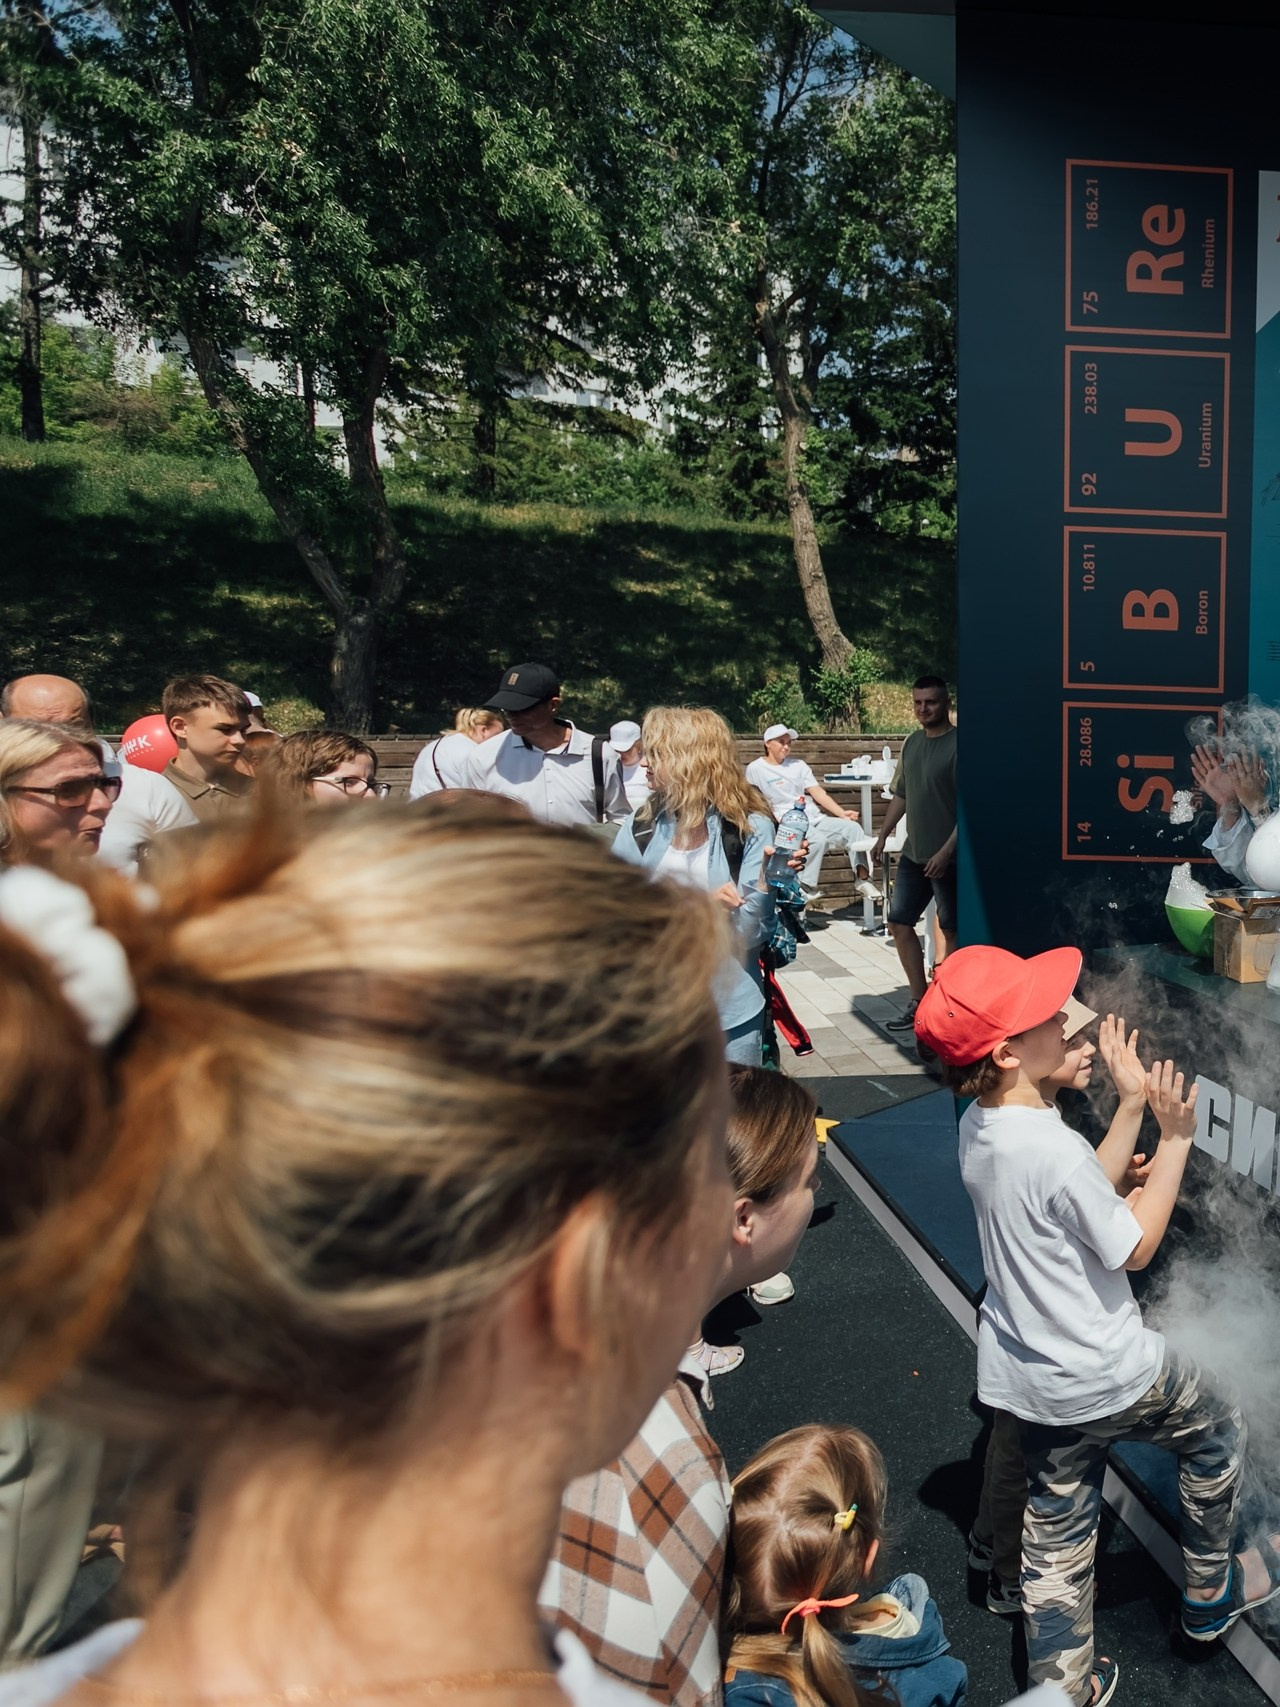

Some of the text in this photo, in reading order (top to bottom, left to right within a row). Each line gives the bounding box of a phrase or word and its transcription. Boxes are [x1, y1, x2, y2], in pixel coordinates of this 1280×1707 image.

[1086, 177, 1099, 230] 186.21
[1126, 203, 1186, 295] Re
[1202, 218, 1215, 288] Rhenium
[1082, 291, 1099, 314] 75
[1084, 362, 1098, 415] 238.03
[1124, 408, 1183, 457] U
[1198, 402, 1213, 468] Uranium
[1081, 472, 1097, 495] 92
[1082, 543, 1096, 592] 10.811
[1122, 588, 1179, 631] B
[1195, 590, 1209, 635] Boron
[1080, 660, 1095, 672] 5
[1079, 717, 1093, 767] 28.086
[1116, 753, 1175, 813] Si
[1076, 821, 1092, 843] 14
